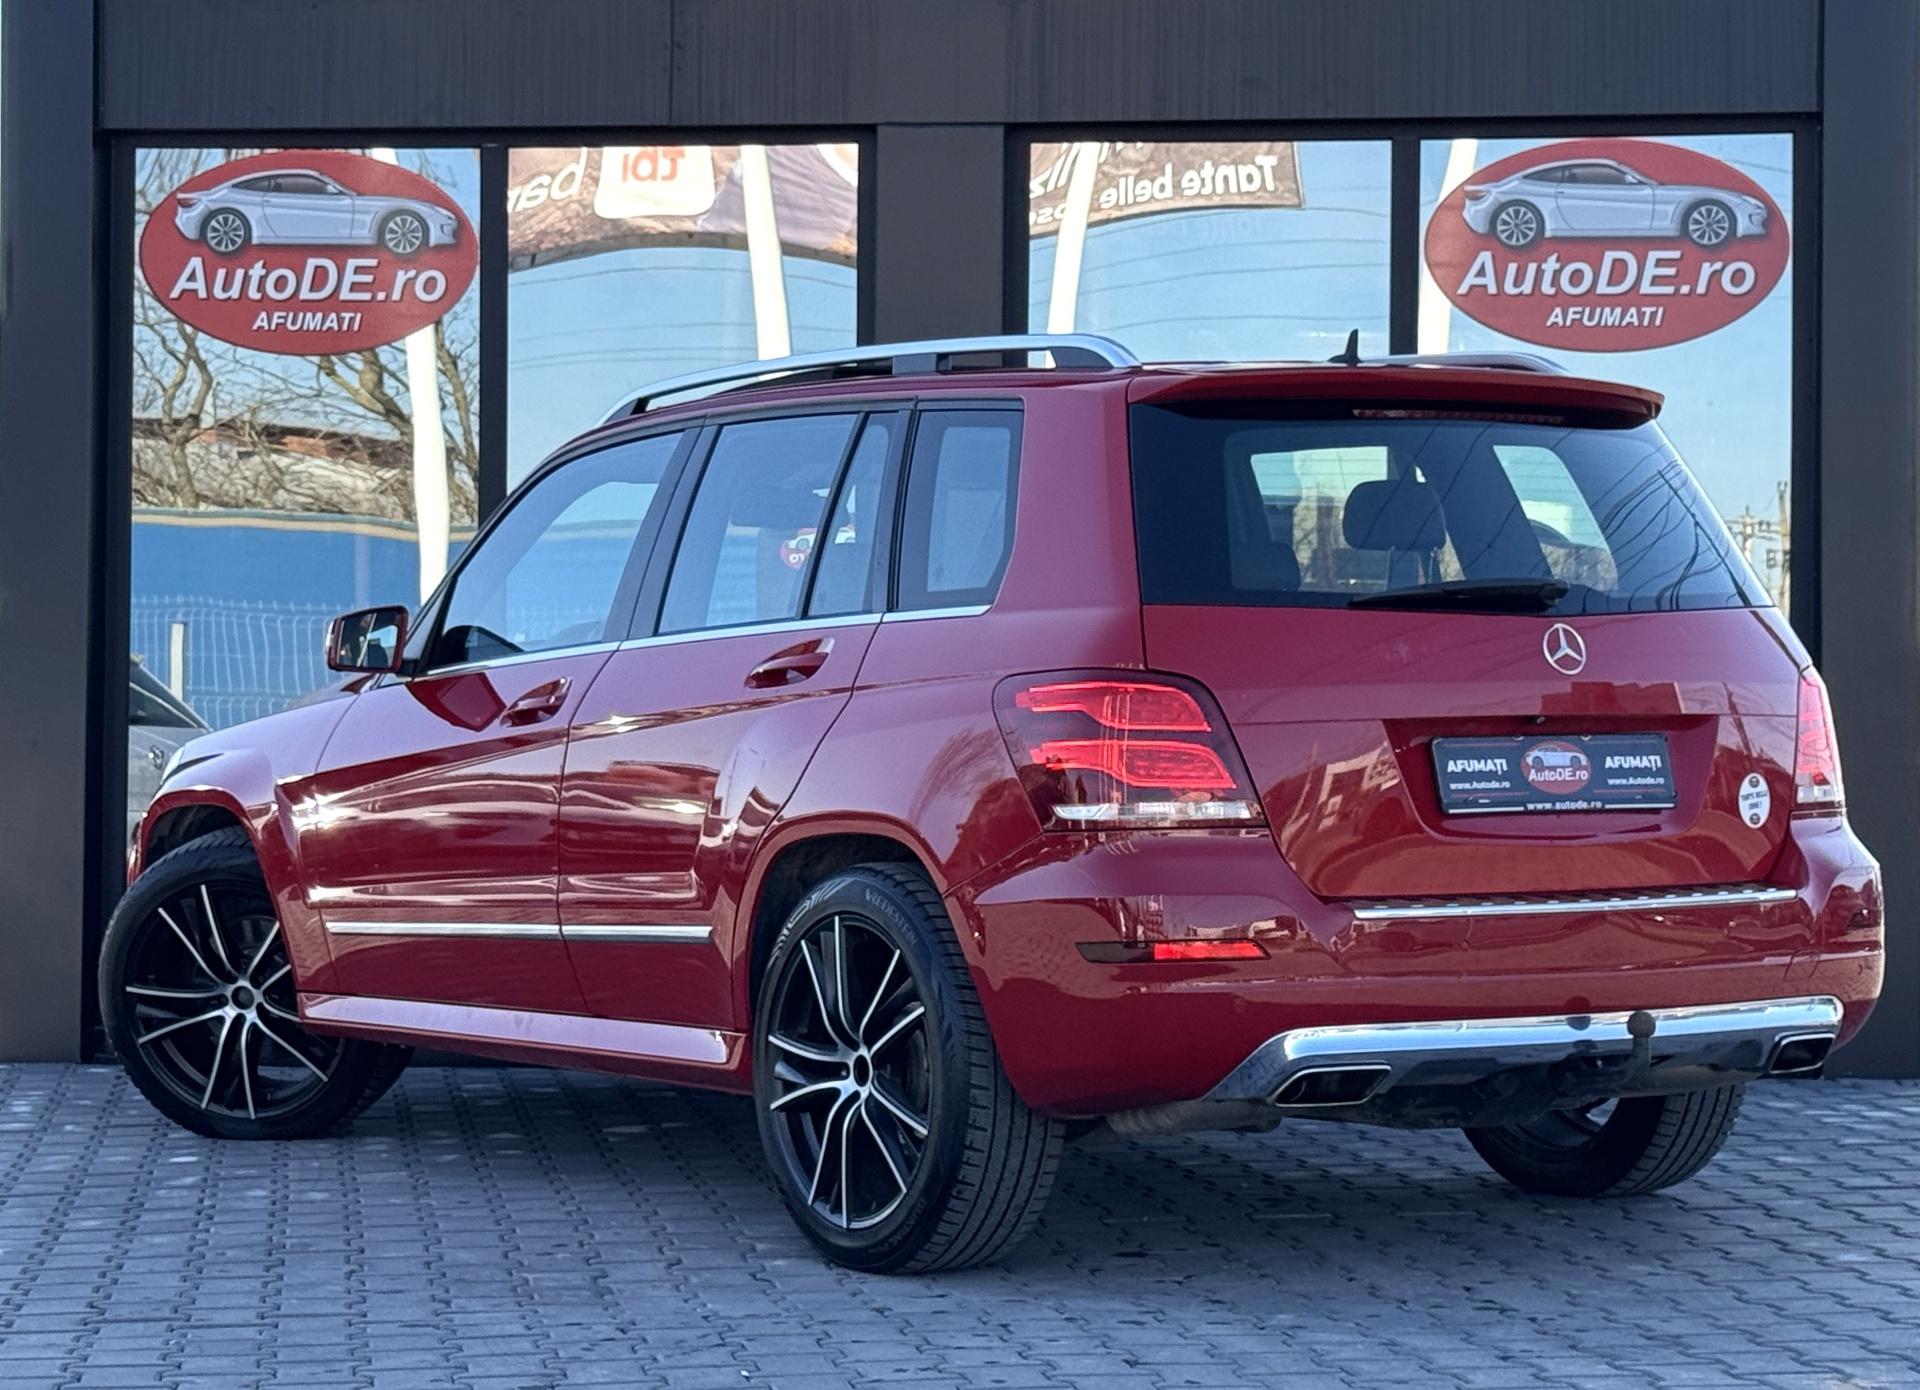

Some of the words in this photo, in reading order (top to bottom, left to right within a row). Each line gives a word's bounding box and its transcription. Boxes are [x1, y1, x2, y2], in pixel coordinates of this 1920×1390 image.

[169, 256, 448, 302] AutoDE.ro
[1456, 249, 1757, 297] AutoDE.ro
[252, 311, 362, 332] AFUMATI
[1545, 306, 1664, 328] AFUMATI
[1528, 767, 1589, 782] AutoDE.ro
